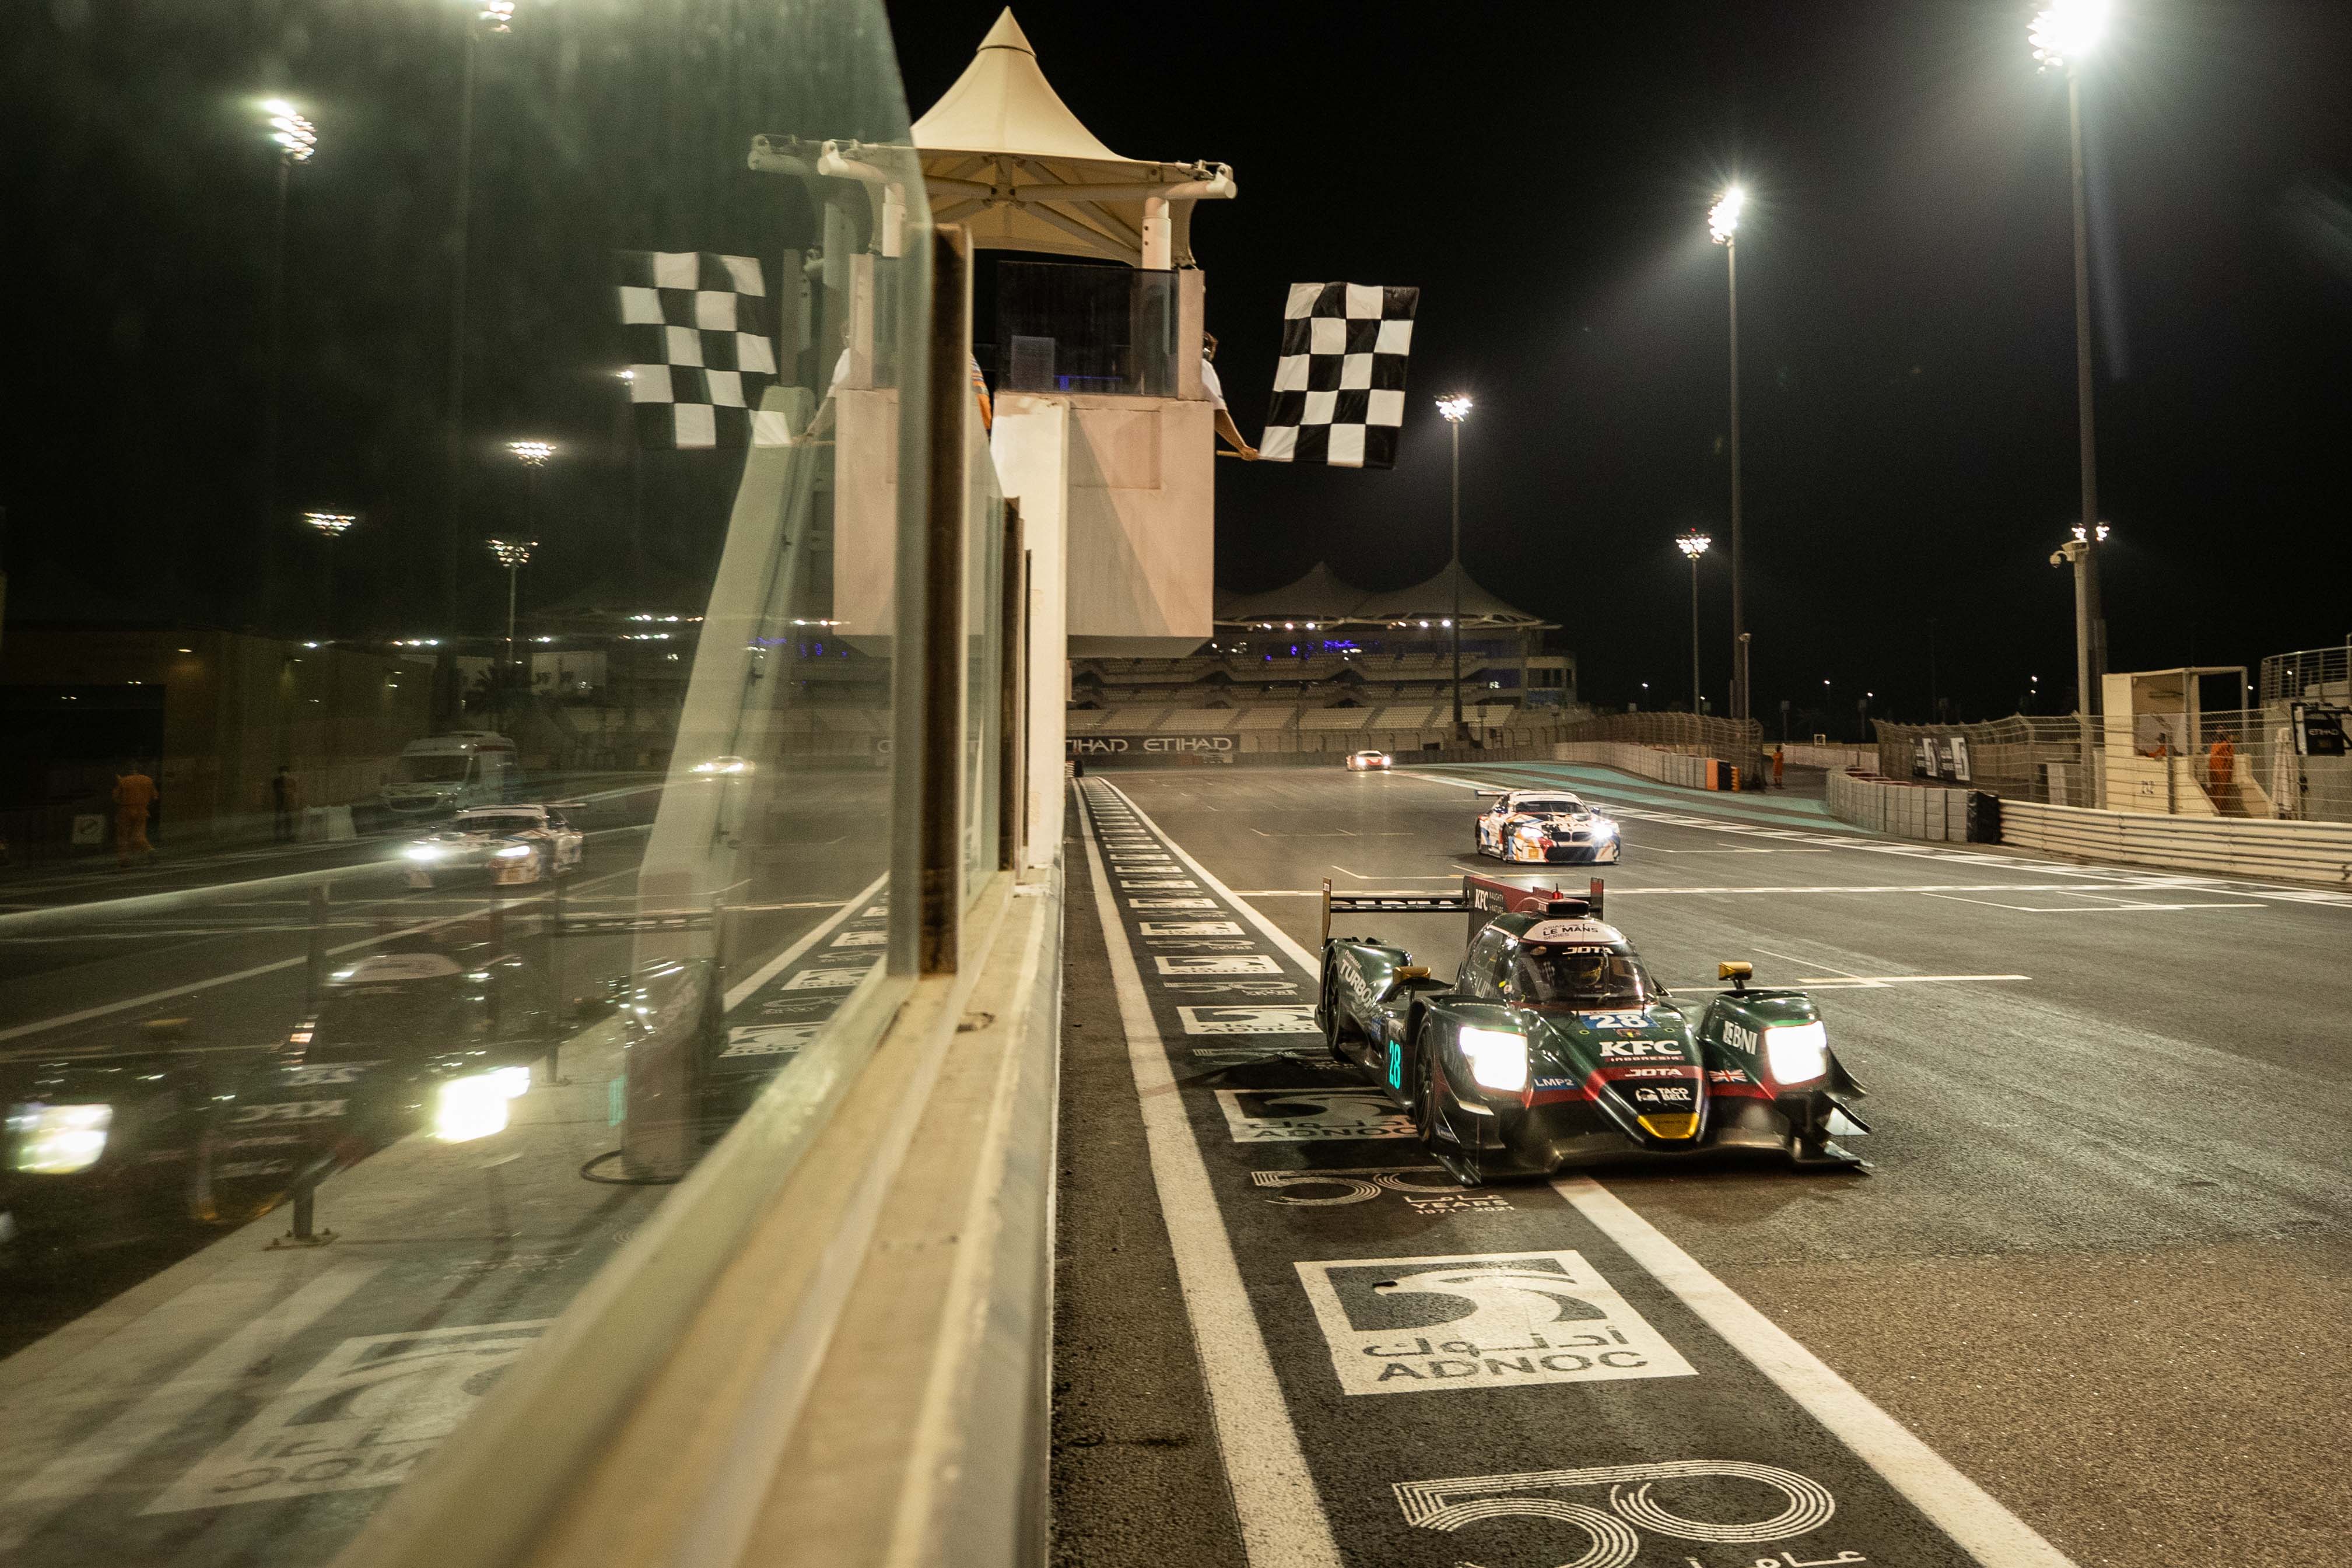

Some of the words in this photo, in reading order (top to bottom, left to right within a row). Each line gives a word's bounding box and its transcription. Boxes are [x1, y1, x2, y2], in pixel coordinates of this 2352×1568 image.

[1143, 737, 1232, 753] ETIHAD
[1474, 889, 1488, 911] KFC
[1562, 946, 1614, 955] JOTA
[1589, 1015, 1649, 1029] 28
[1732, 1025, 1758, 1055] BNI
[1599, 1040, 1682, 1057] KFC
[1389, 1040, 1401, 1089] 28
[1625, 1068, 1684, 1077] JOTA
[1534, 1078, 1575, 1087] LMP2
[1411, 1200, 1509, 1209] YEARS
[1377, 1352, 1648, 1381] ADNOC
